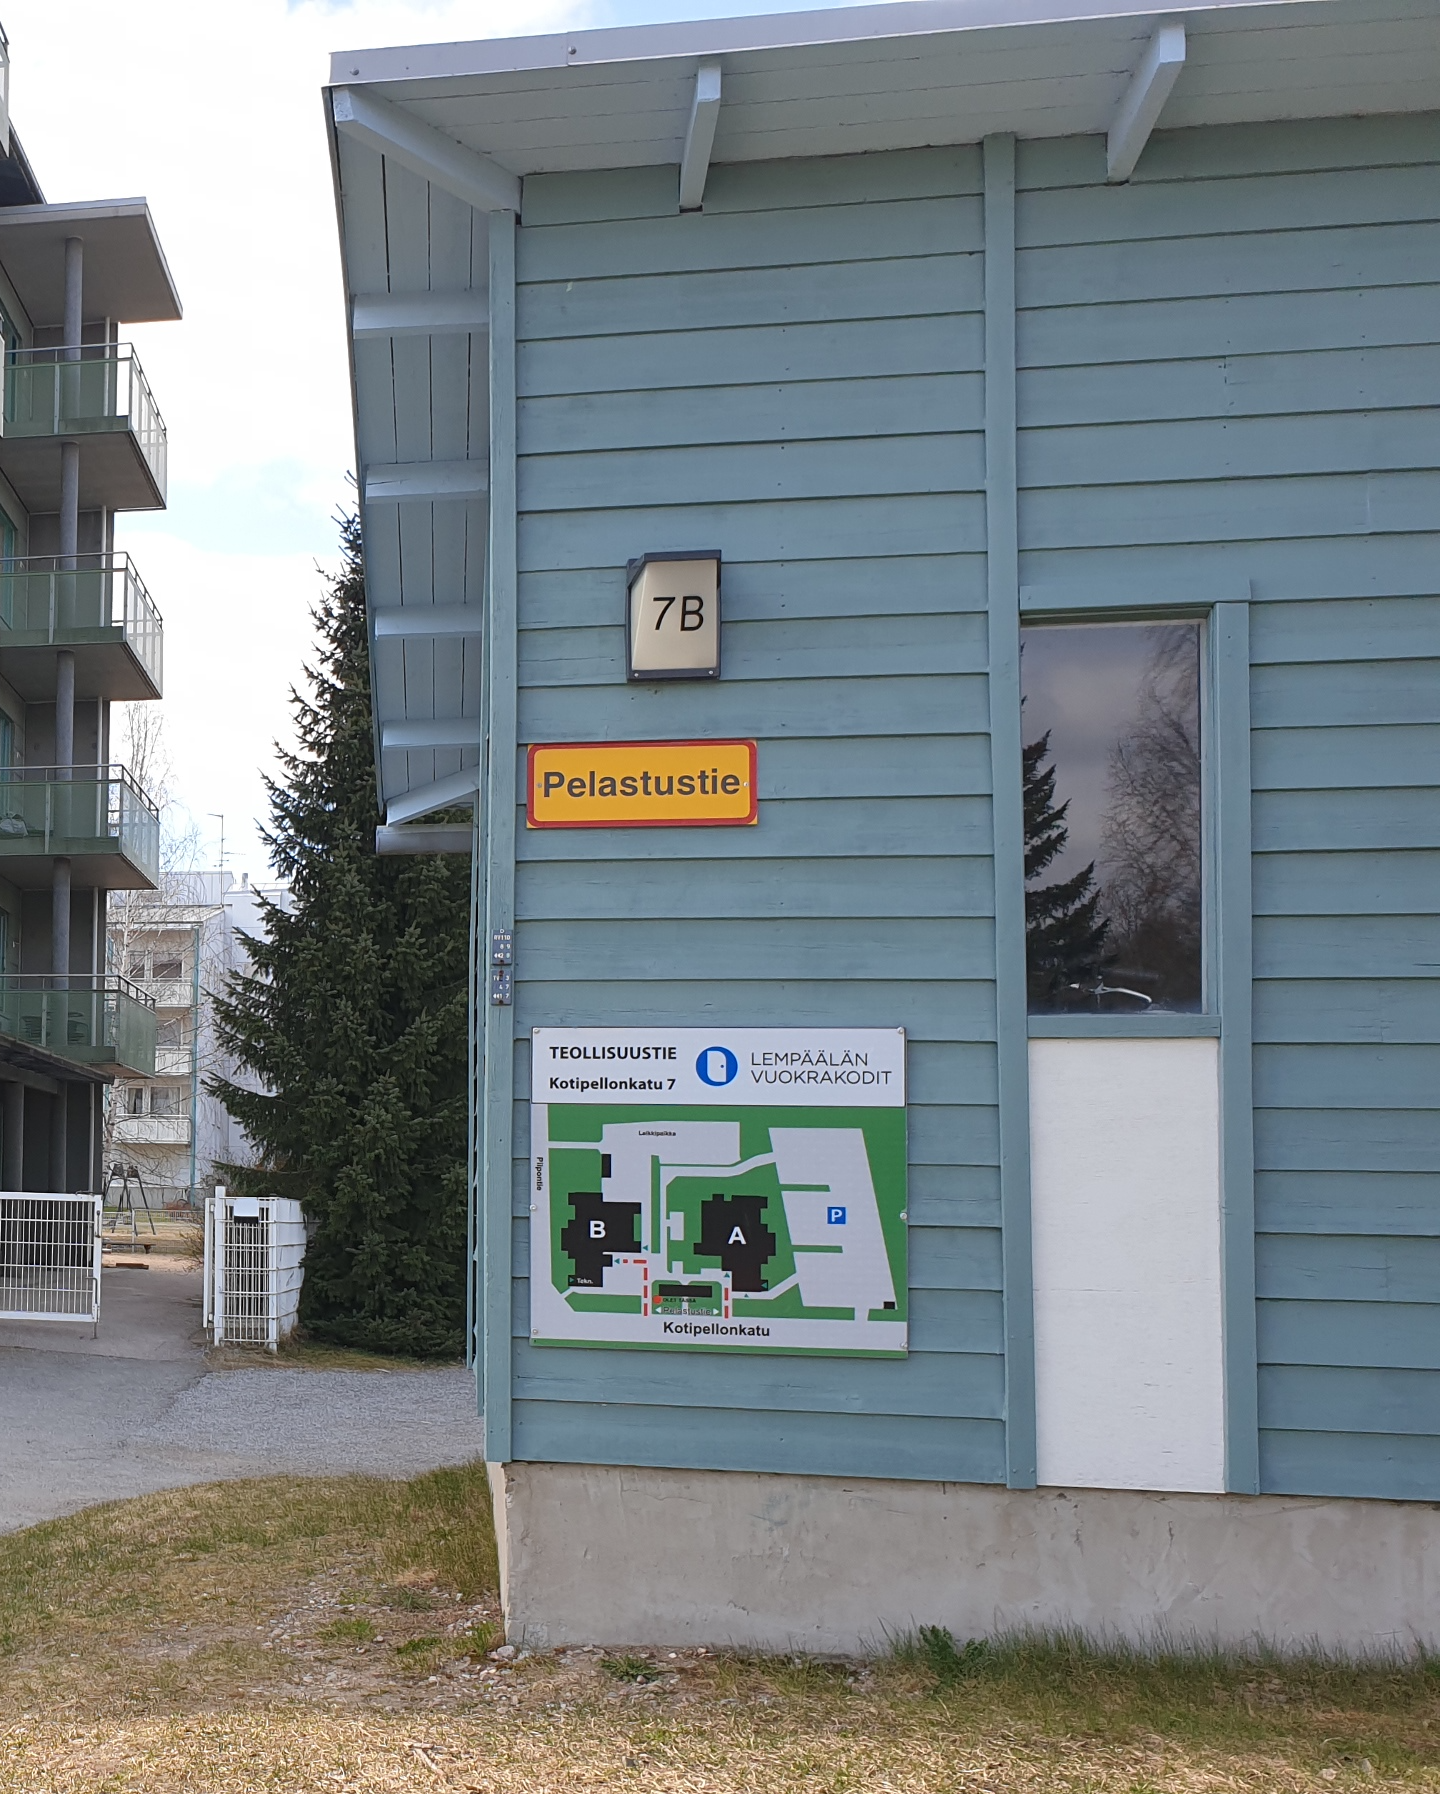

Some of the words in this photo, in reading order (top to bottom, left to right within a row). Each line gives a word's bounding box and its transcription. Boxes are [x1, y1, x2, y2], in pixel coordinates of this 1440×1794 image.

[652, 595, 704, 631] 7B
[543, 768, 741, 798] Pelastustie
[549, 1046, 677, 1059] TEOLLISUUSTIE
[751, 1049, 868, 1066] LEMPÄÄLÄN
[549, 1077, 663, 1092] Kotipellonkatu
[667, 1079, 676, 1090] 7
[751, 1070, 892, 1084] VUOKRAKODIT
[831, 1209, 842, 1222] P
[589, 1220, 606, 1238] B
[728, 1226, 747, 1245] A
[663, 1322, 770, 1337] Kotipellonkatu
